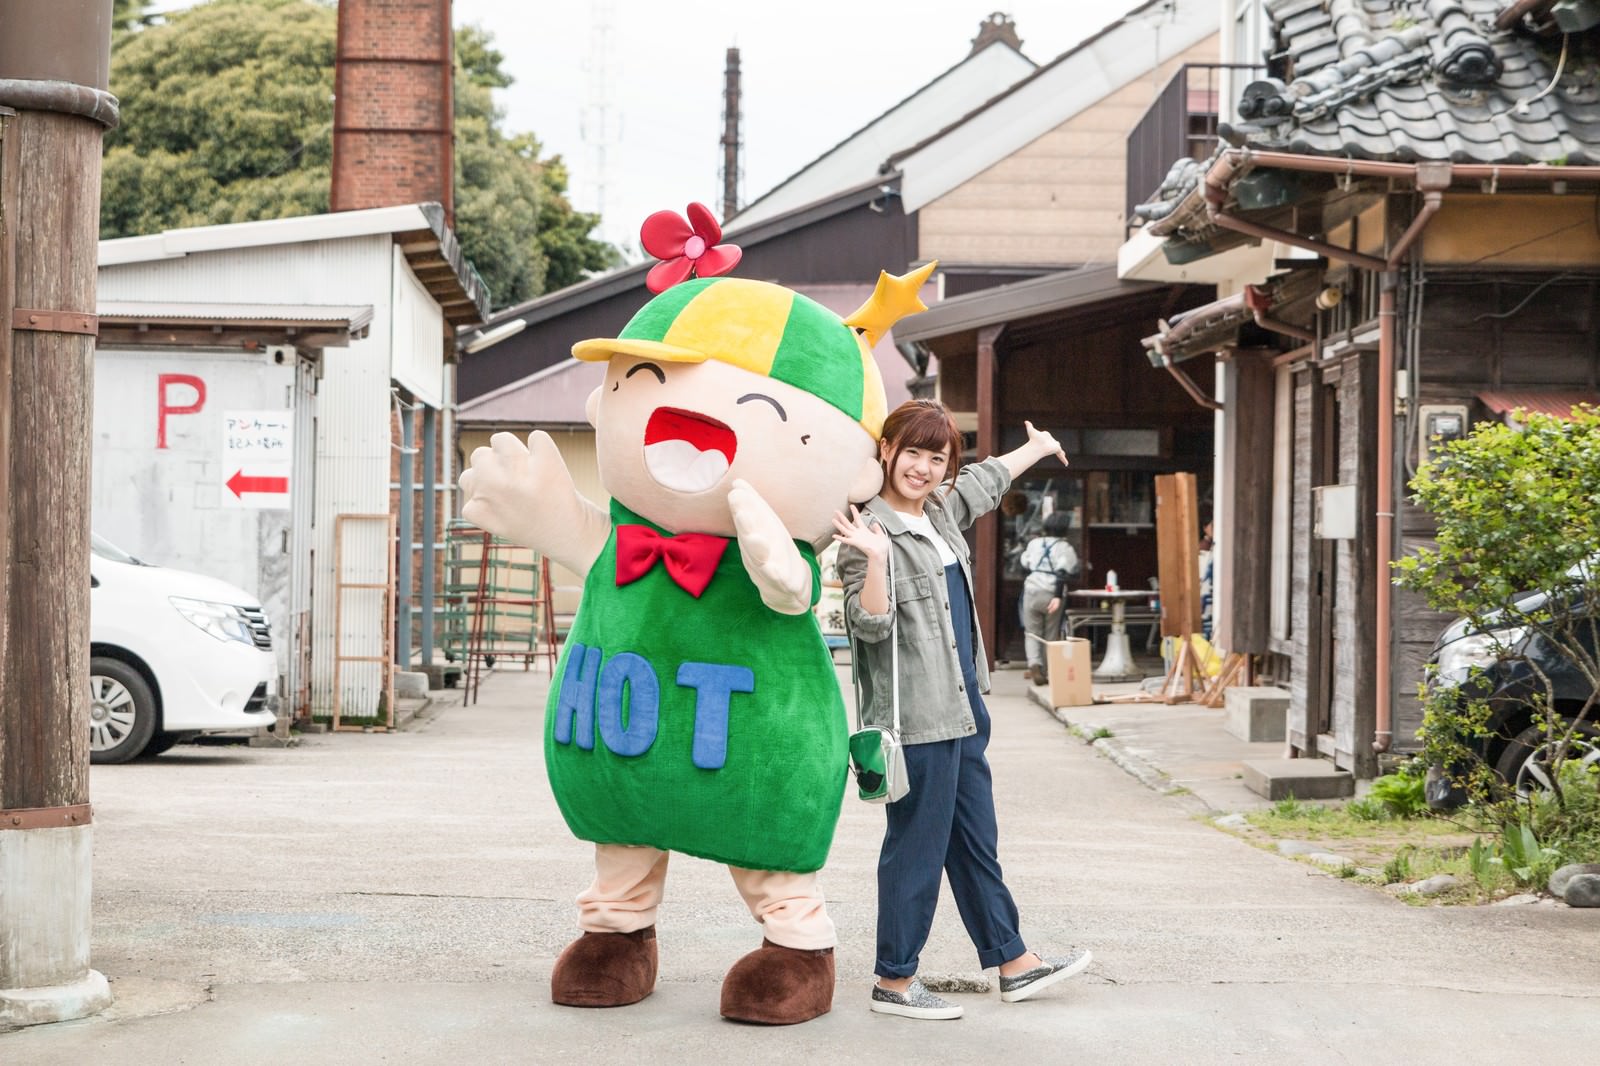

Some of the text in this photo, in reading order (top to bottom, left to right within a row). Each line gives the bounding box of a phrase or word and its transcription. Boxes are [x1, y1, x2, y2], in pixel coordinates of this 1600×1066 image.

[157, 373, 206, 449] P
[226, 418, 288, 431] アンケート
[554, 642, 755, 770] HOT
